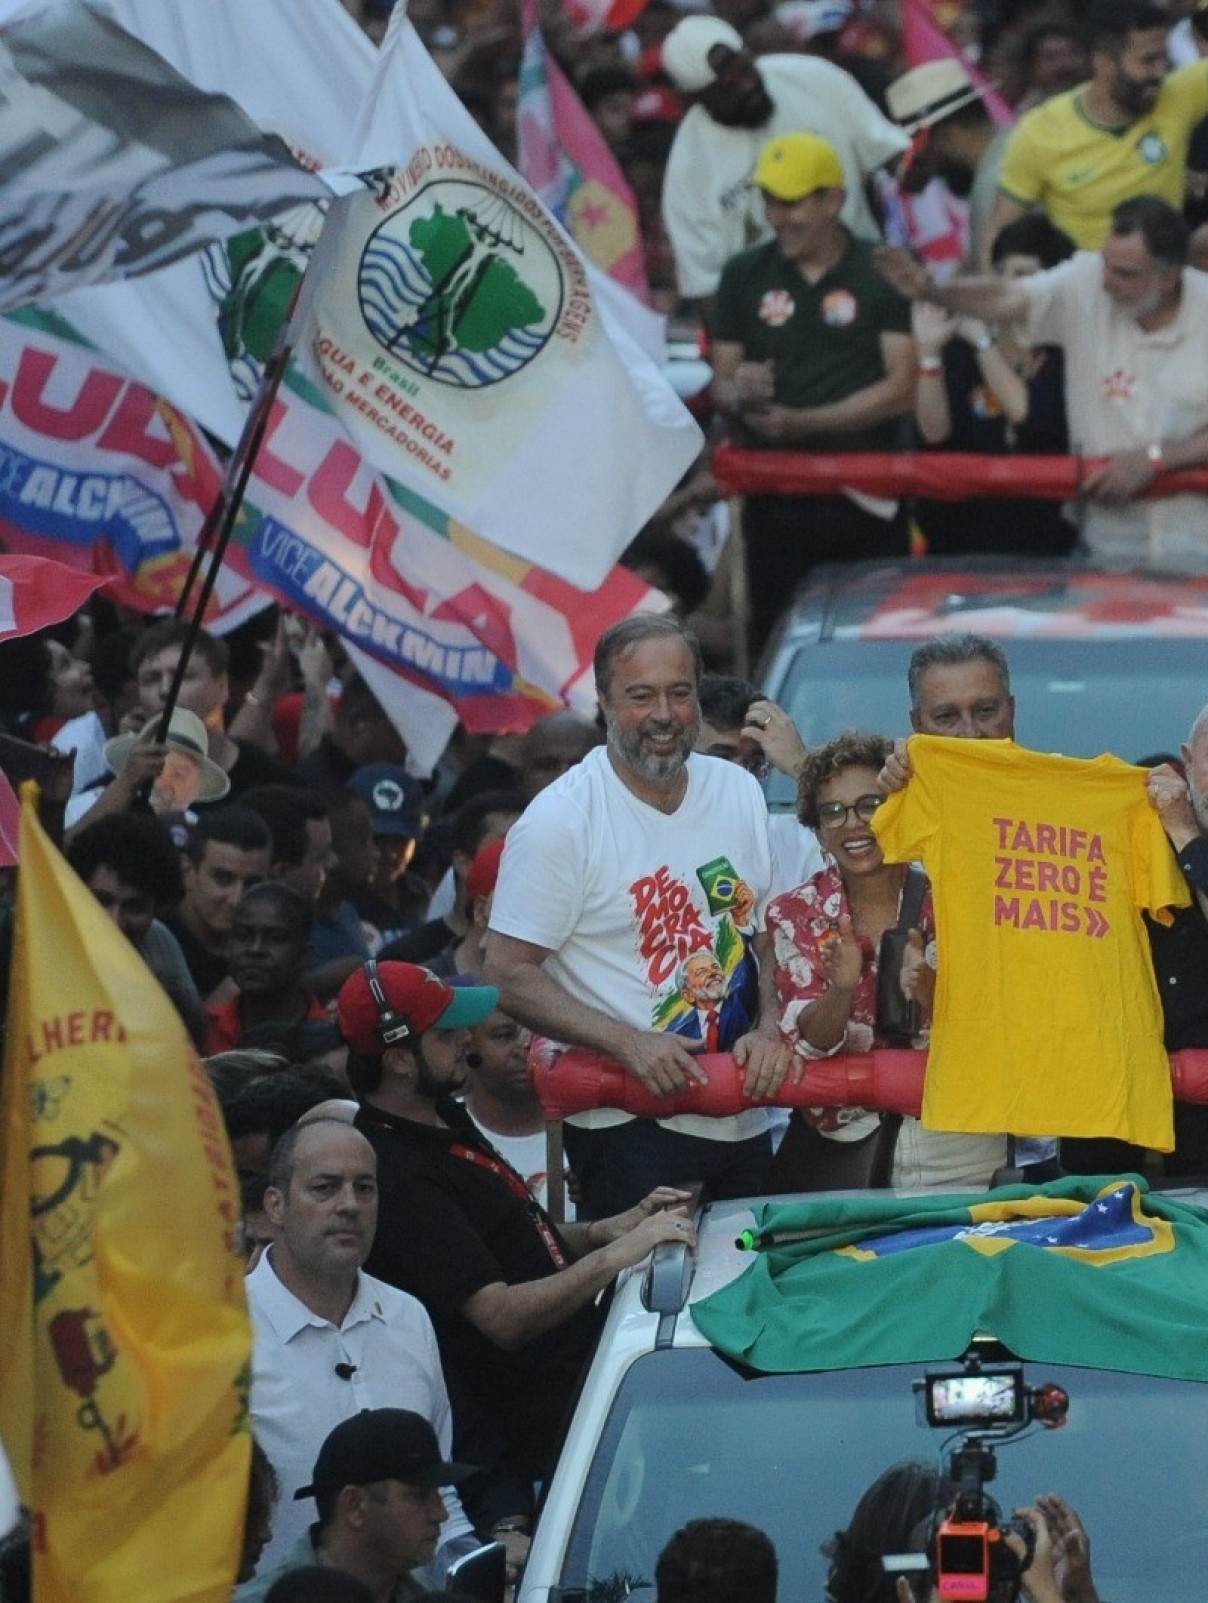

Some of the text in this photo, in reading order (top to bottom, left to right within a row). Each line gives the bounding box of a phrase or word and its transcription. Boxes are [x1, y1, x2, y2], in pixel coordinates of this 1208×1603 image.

[314, 337, 455, 454] GUA E ENERGIA
[372, 355, 421, 397] Brasil
[345, 390, 452, 481] MERCADORIAS
[261, 521, 498, 683] VICE ALCKMIN
[993, 817, 1107, 865] TARIFA
[629, 865, 678, 918] DE
[995, 856, 1107, 902] ZERO É
[640, 885, 689, 934] MO
[640, 902, 704, 960] CRA
[648, 926, 714, 985] CIA
